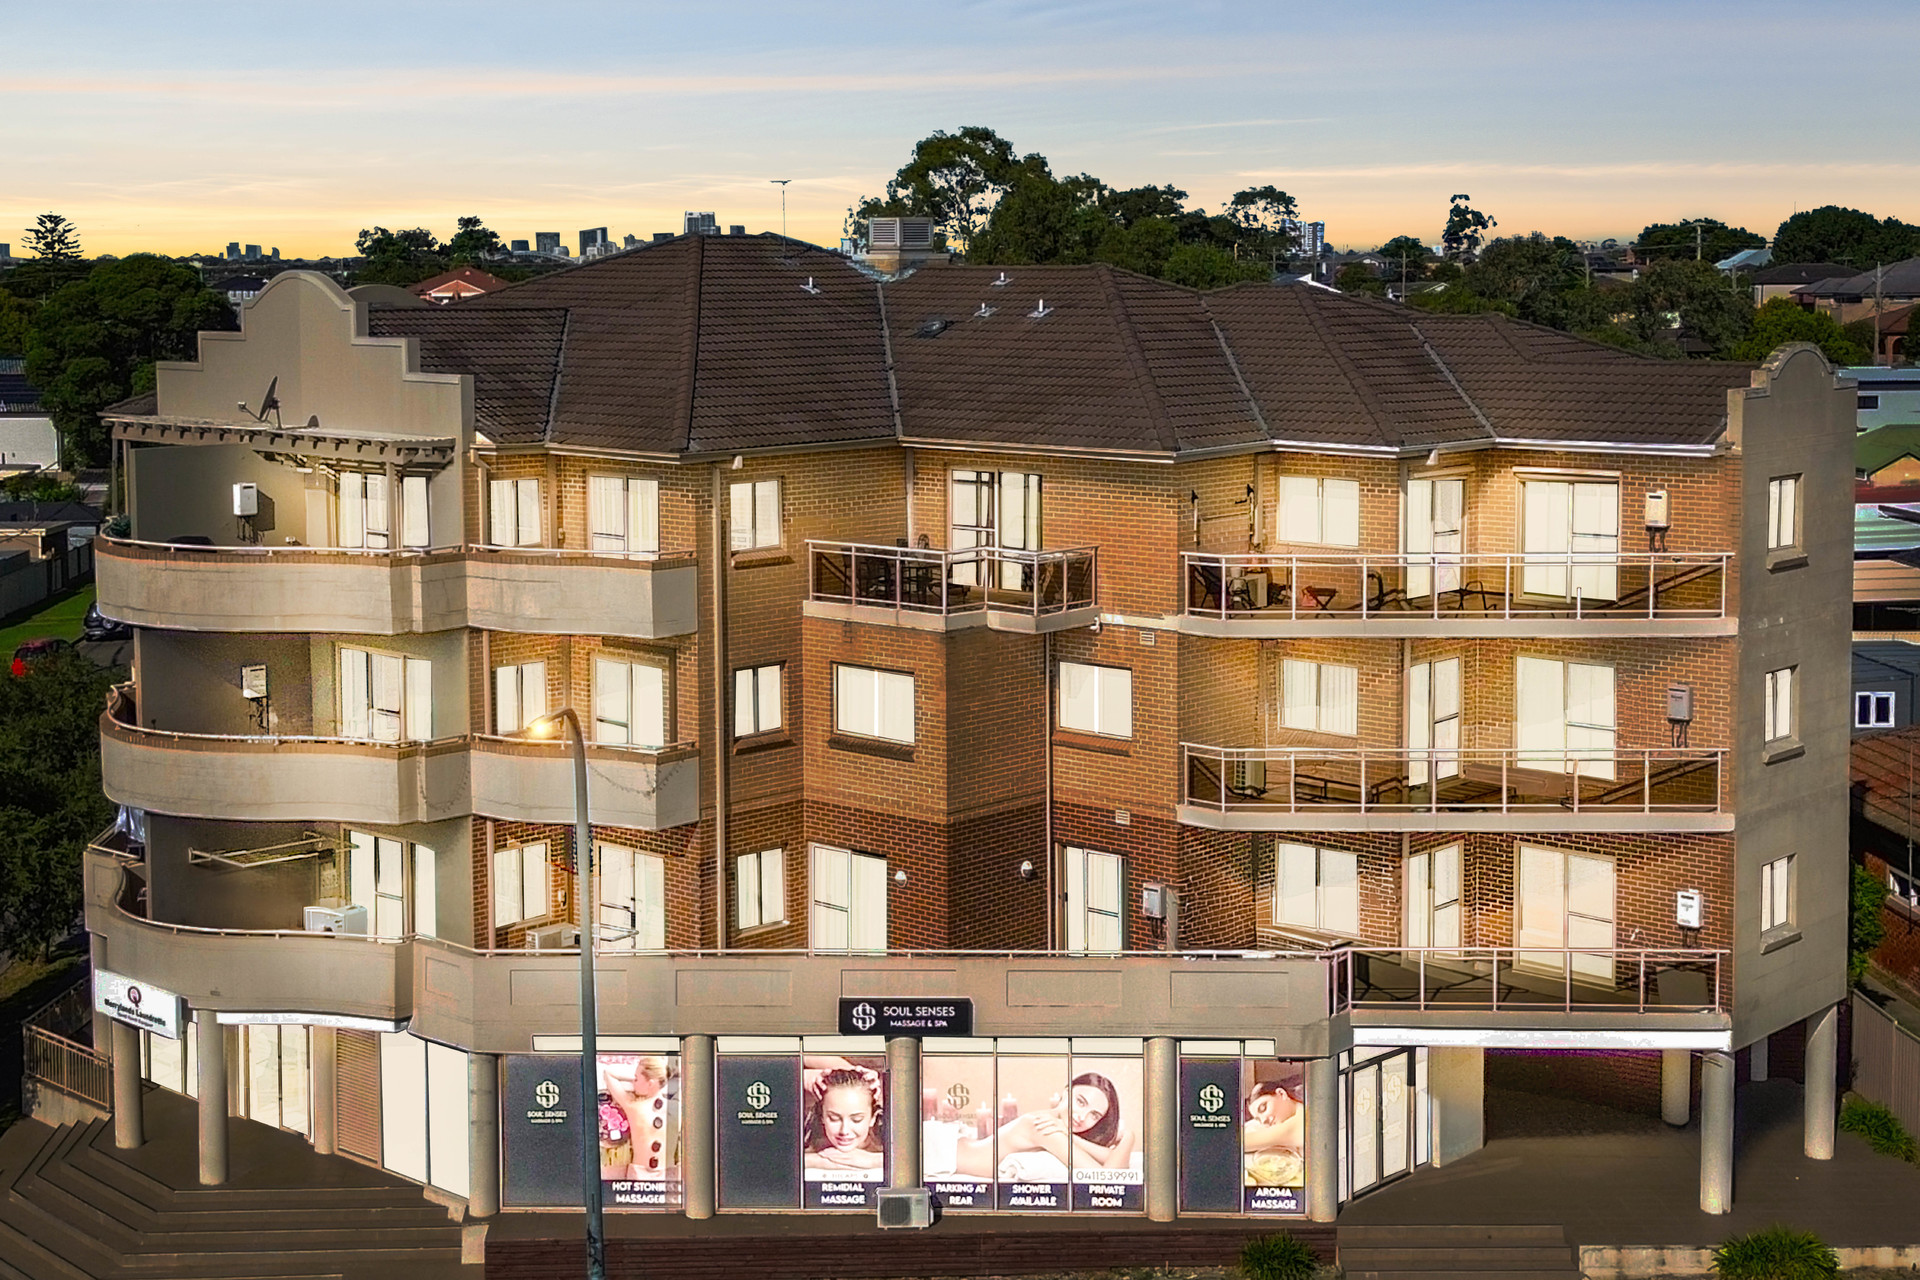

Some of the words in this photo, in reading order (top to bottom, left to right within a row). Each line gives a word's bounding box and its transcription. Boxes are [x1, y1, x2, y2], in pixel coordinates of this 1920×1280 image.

[883, 1006, 913, 1017] SOUL
[915, 1006, 955, 1017] SENSES
[1076, 1170, 1139, 1181] 0411539991
[612, 1181, 632, 1191] HOT
[821, 1183, 865, 1192] REMIDIAL
[935, 1184, 974, 1193] PARKING
[975, 1184, 988, 1193] AT
[1012, 1184, 1052, 1194] SHOWER
[1088, 1185, 1126, 1195] PRIVATE
[1255, 1187, 1293, 1197] AROMA
[821, 1195, 866, 1204] MASSAGE
[949, 1196, 973, 1205] REAR
[1009, 1196, 1057, 1206] AVAILABLE
[1091, 1197, 1123, 1207] ROOM
[1251, 1200, 1297, 1209] MASSAGE
